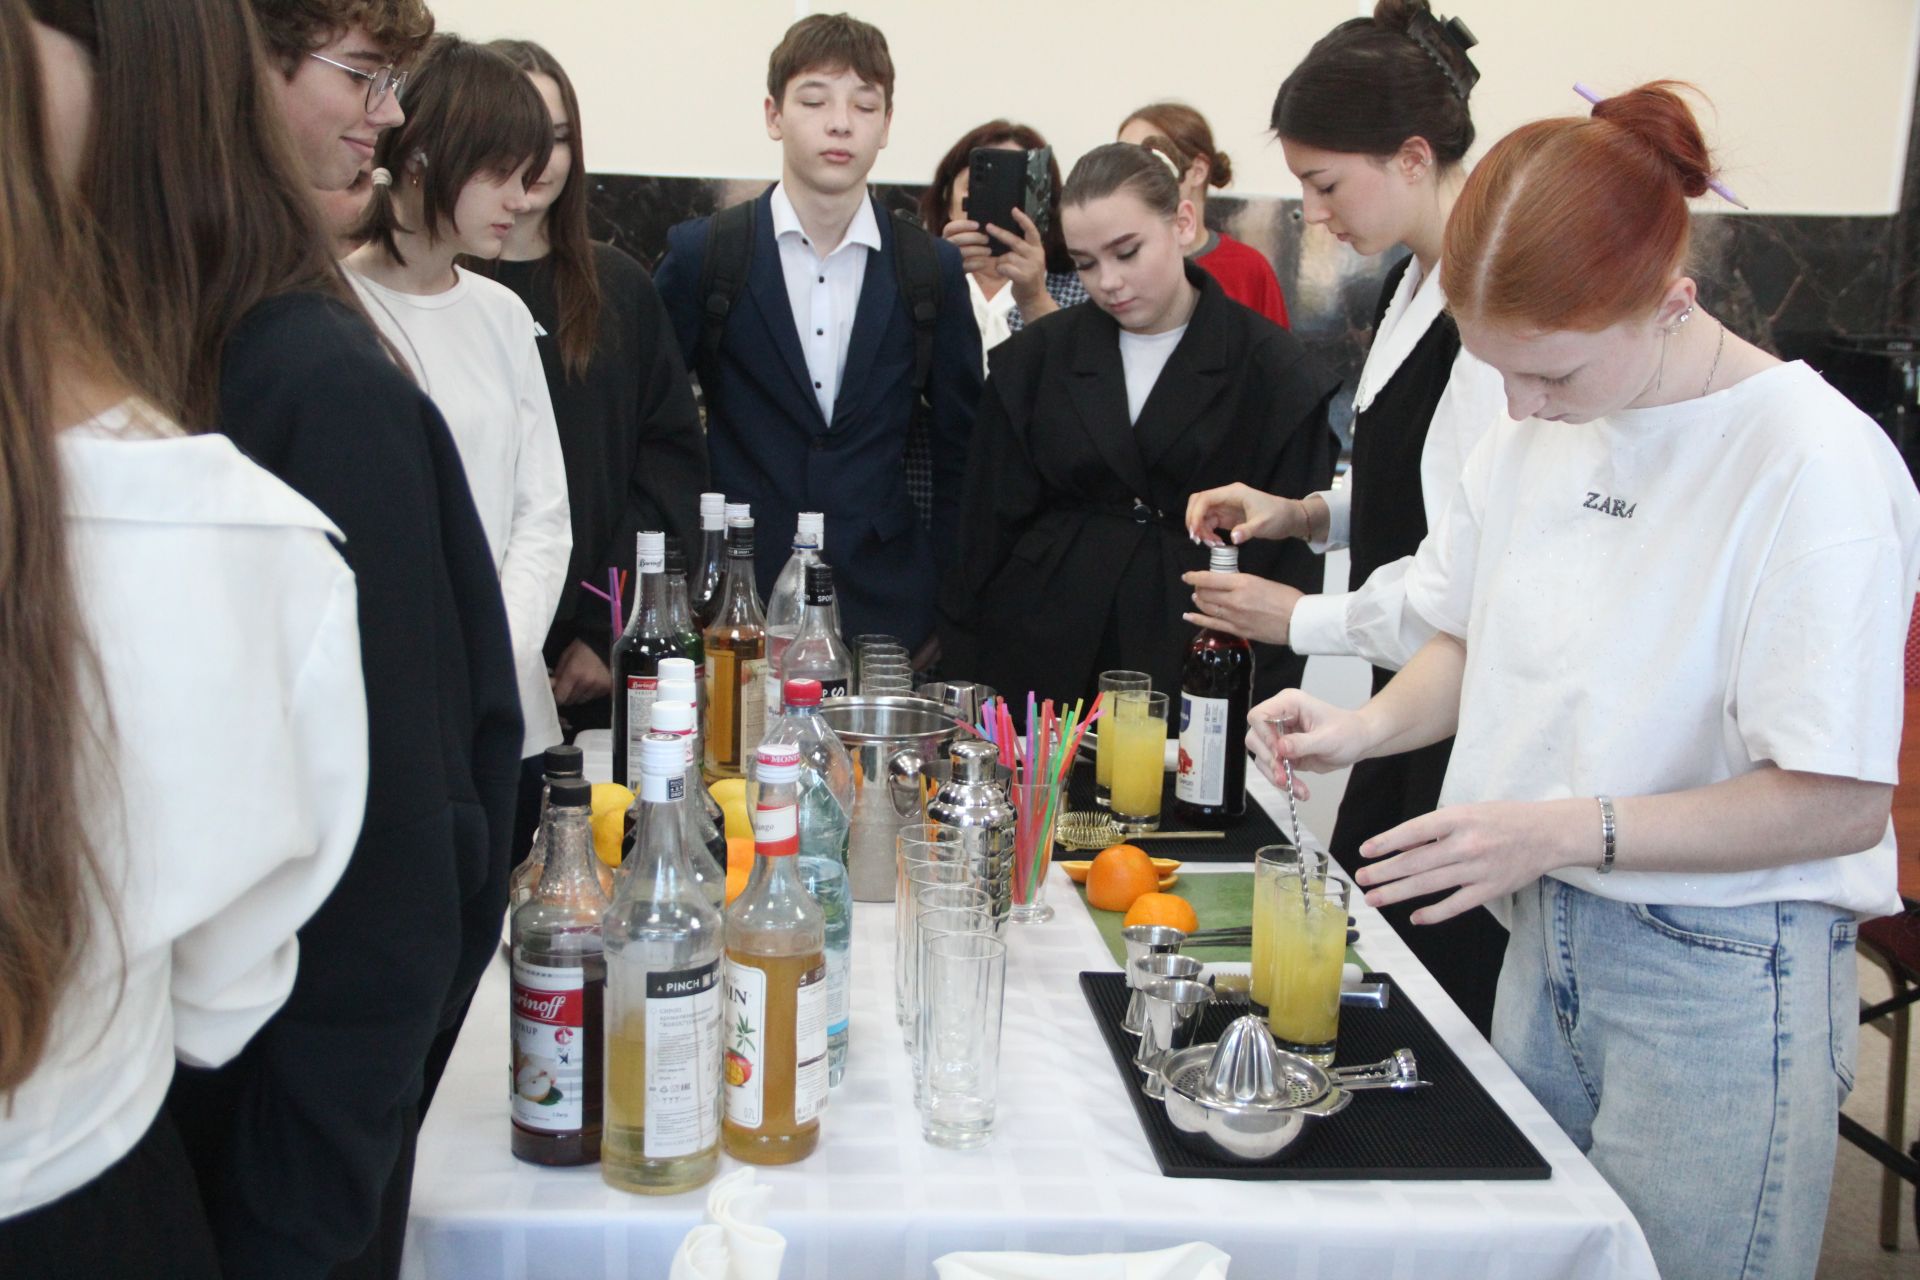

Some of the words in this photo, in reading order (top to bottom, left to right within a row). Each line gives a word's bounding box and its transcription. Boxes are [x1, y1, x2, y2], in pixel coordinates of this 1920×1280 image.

[1583, 492, 1637, 518] ZARA
[666, 978, 700, 992] PINCH
[516, 993, 566, 1019] rinoff
